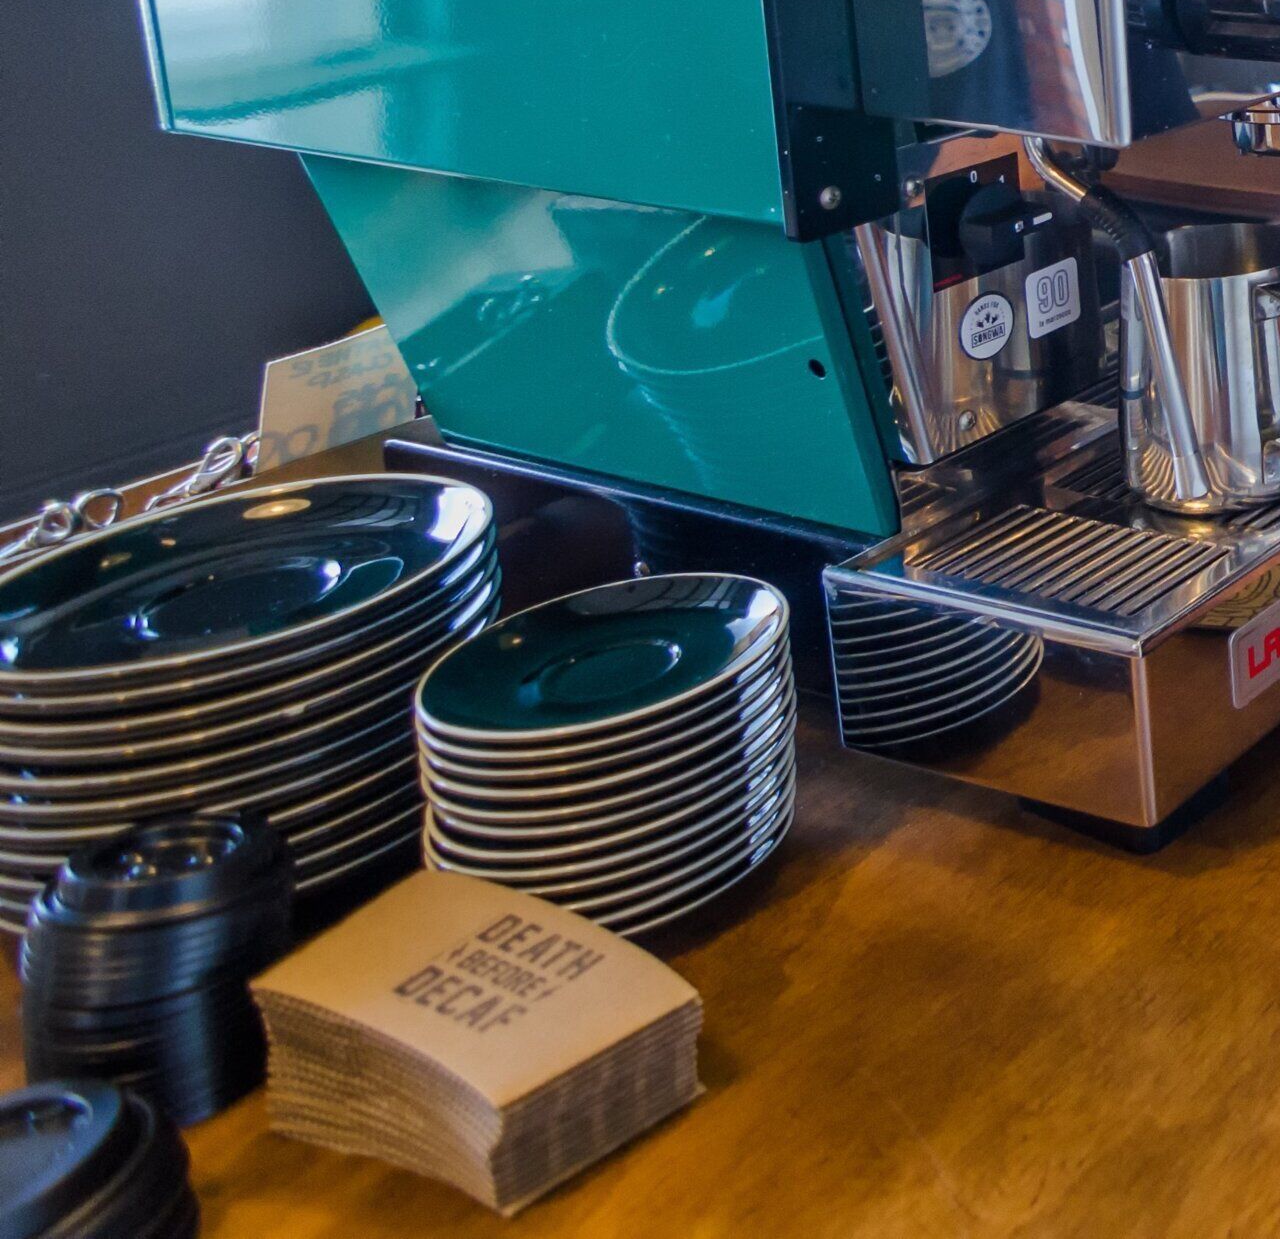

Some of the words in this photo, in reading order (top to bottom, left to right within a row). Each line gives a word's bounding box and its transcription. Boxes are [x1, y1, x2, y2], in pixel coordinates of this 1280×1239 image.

[1036, 269, 1070, 314] 90
[455, 949, 548, 997] BEFORE
[476, 913, 606, 981] DEATH
[393, 964, 528, 1033] DECAF
